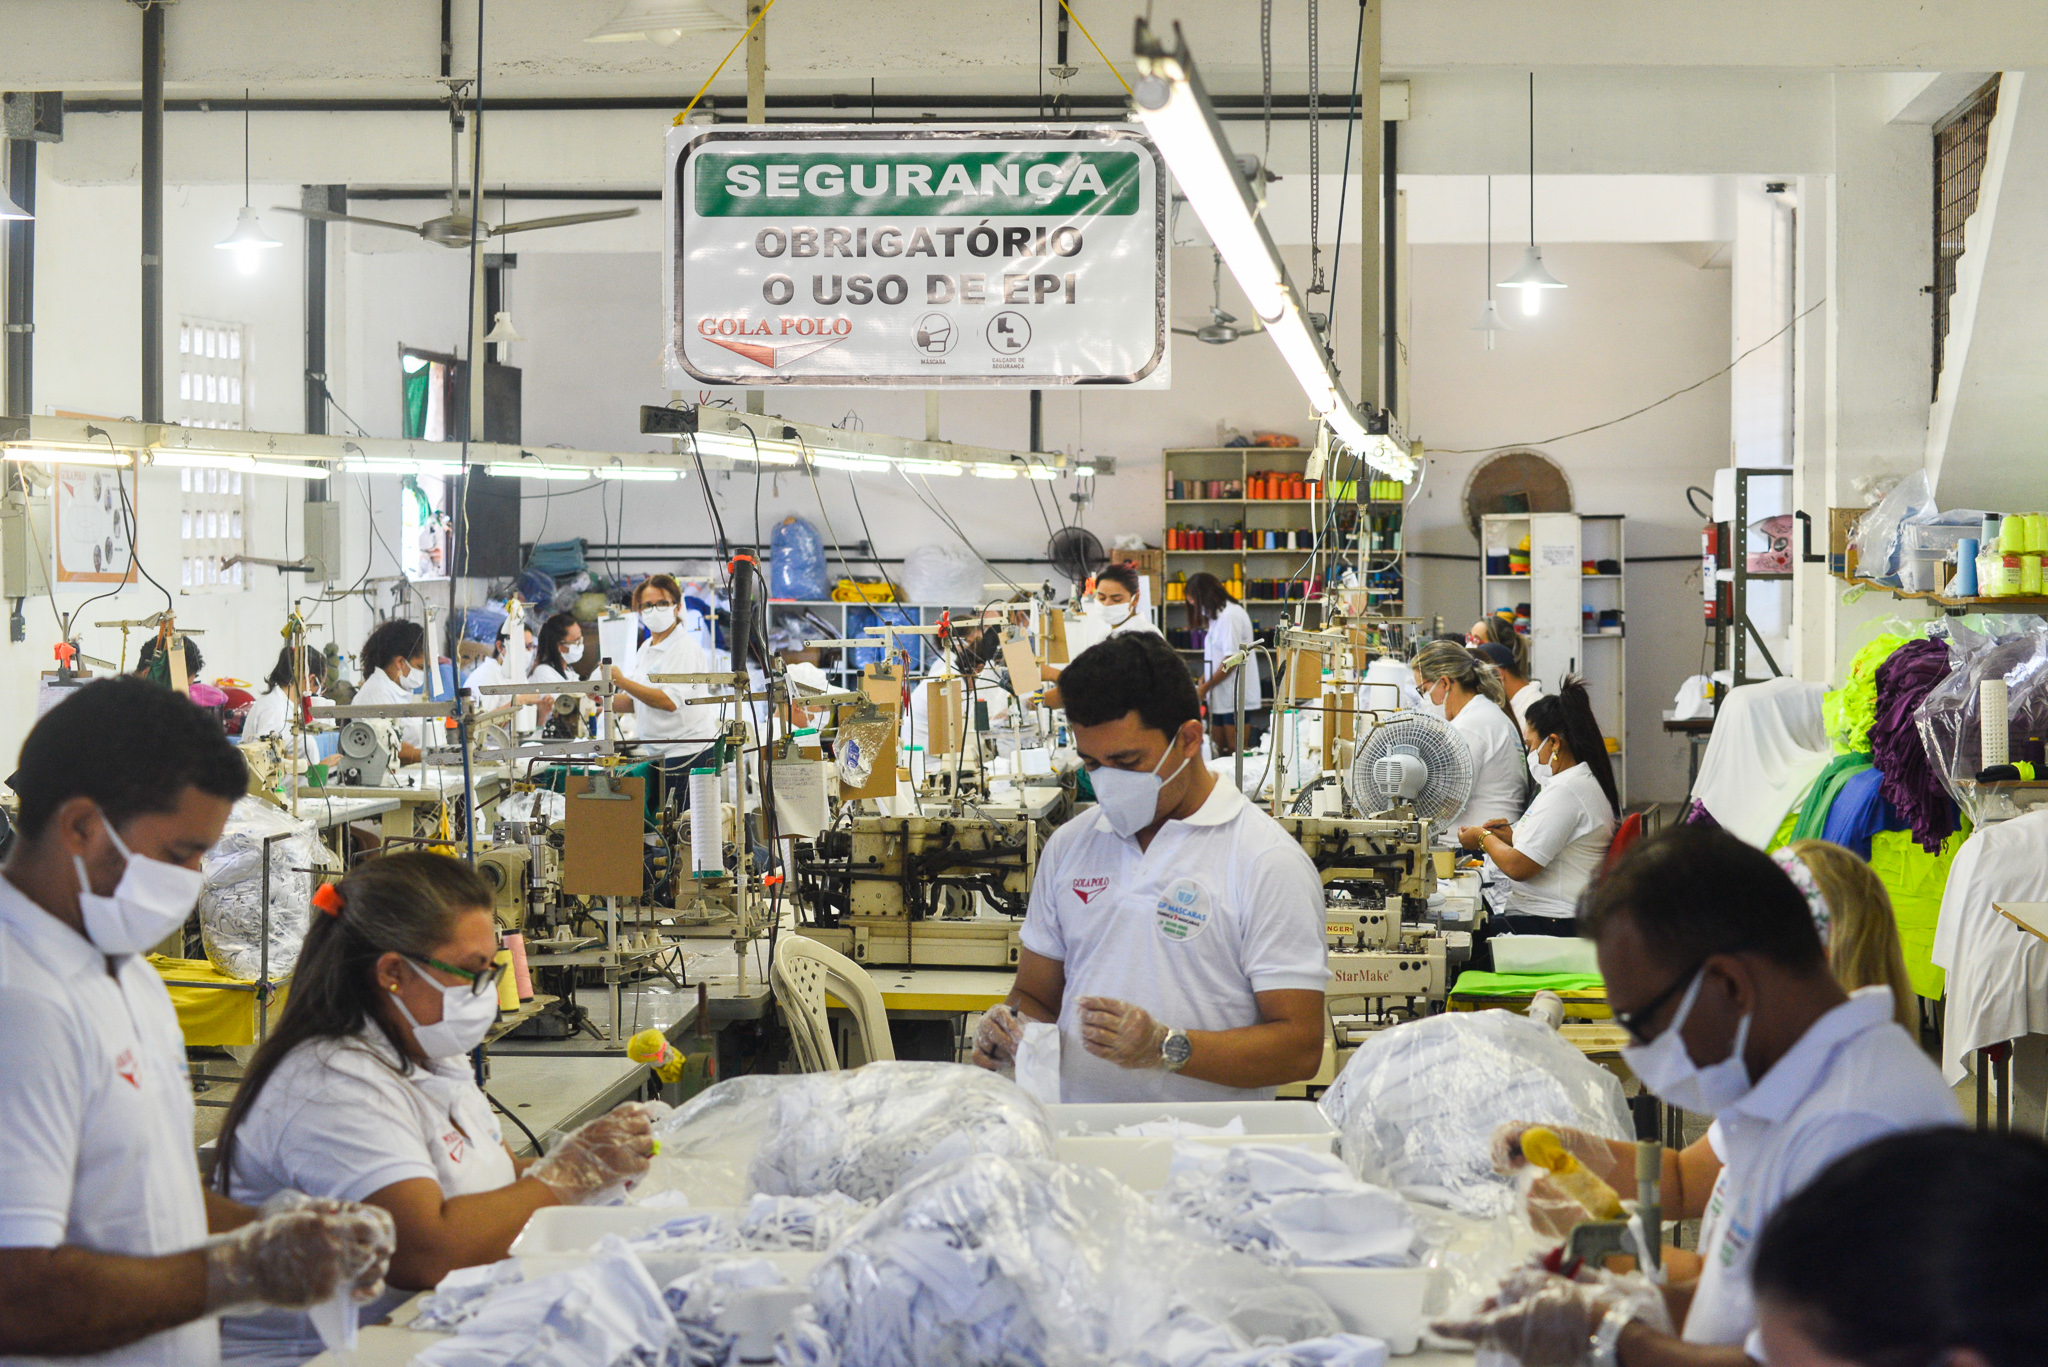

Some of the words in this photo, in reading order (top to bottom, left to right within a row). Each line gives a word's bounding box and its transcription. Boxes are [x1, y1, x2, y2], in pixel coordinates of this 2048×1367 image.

[725, 164, 1108, 205] SEGURANÇA
[755, 219, 1083, 258] OBRIGATÓRIO
[762, 274, 795, 305] O
[812, 274, 909, 305] USO
[926, 274, 986, 305] DE
[1004, 274, 1076, 305] EPI
[697, 318, 773, 336] GOLA
[779, 318, 853, 336] POLO
